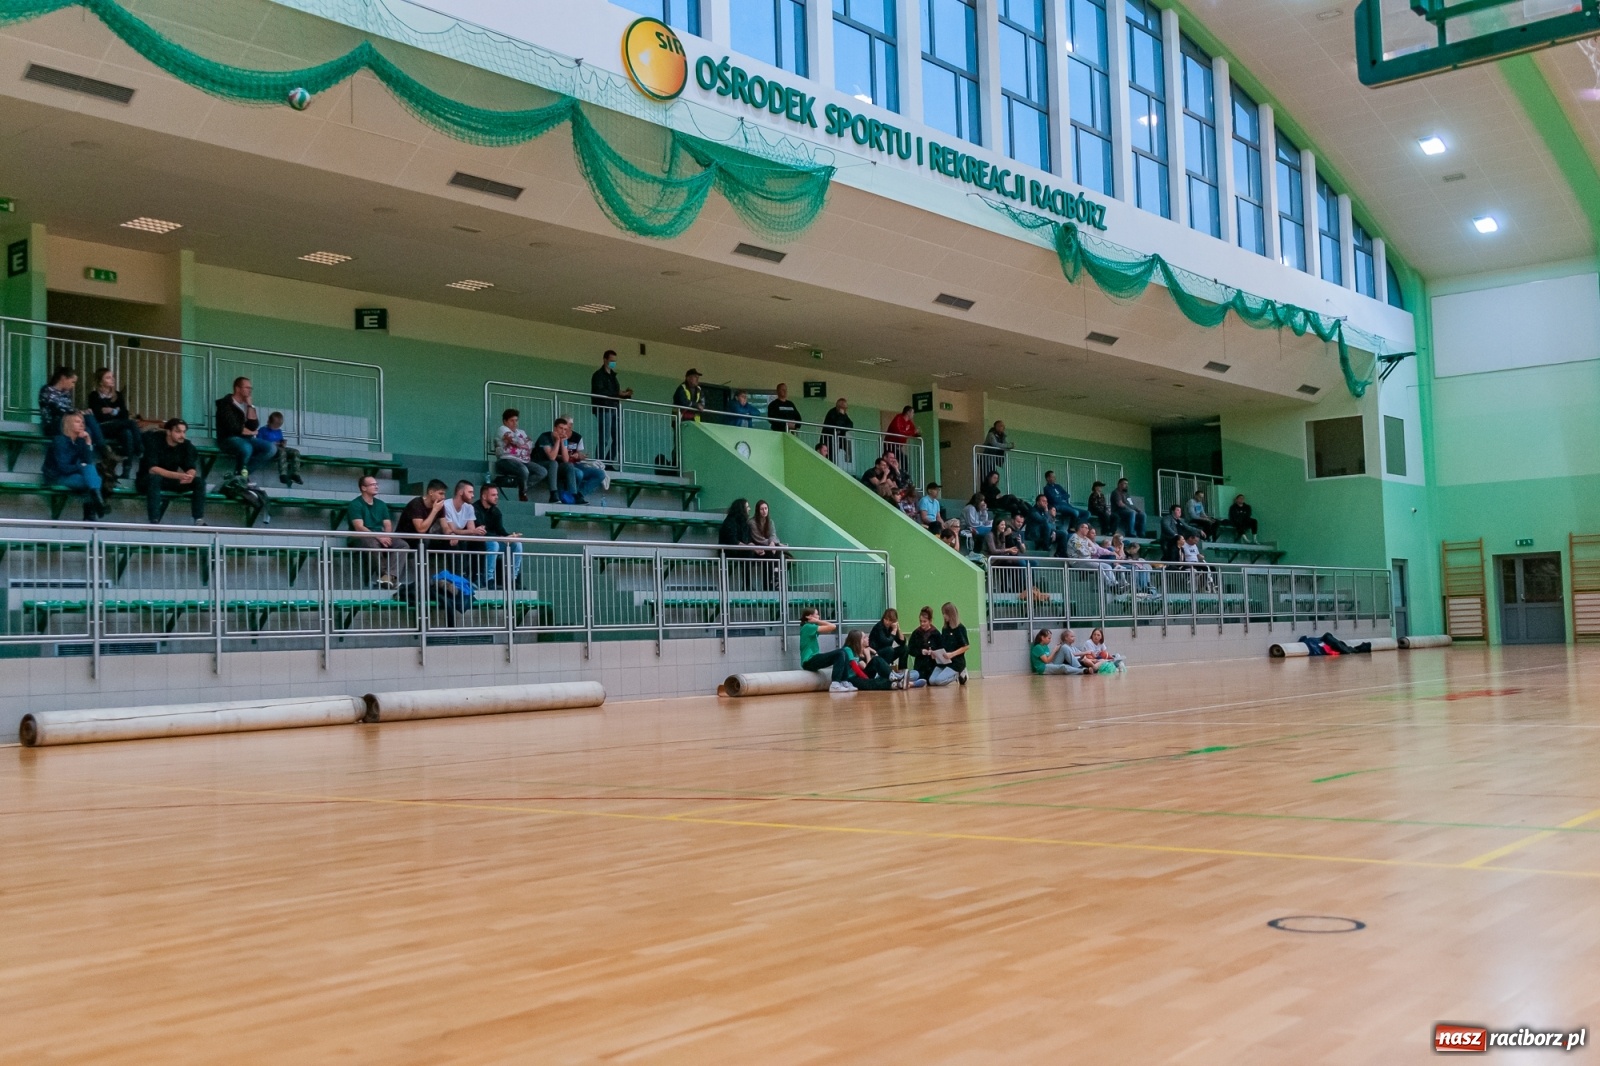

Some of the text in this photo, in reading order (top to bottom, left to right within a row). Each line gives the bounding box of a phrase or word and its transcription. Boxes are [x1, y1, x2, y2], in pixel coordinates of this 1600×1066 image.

[695, 55, 1107, 231] OŚRODEK SPORTU I REKREACJI RACIBÓRZ
[12, 252, 24, 272] E
[363, 315, 379, 328] E
[810, 386, 821, 397] F
[918, 399, 928, 410] F
